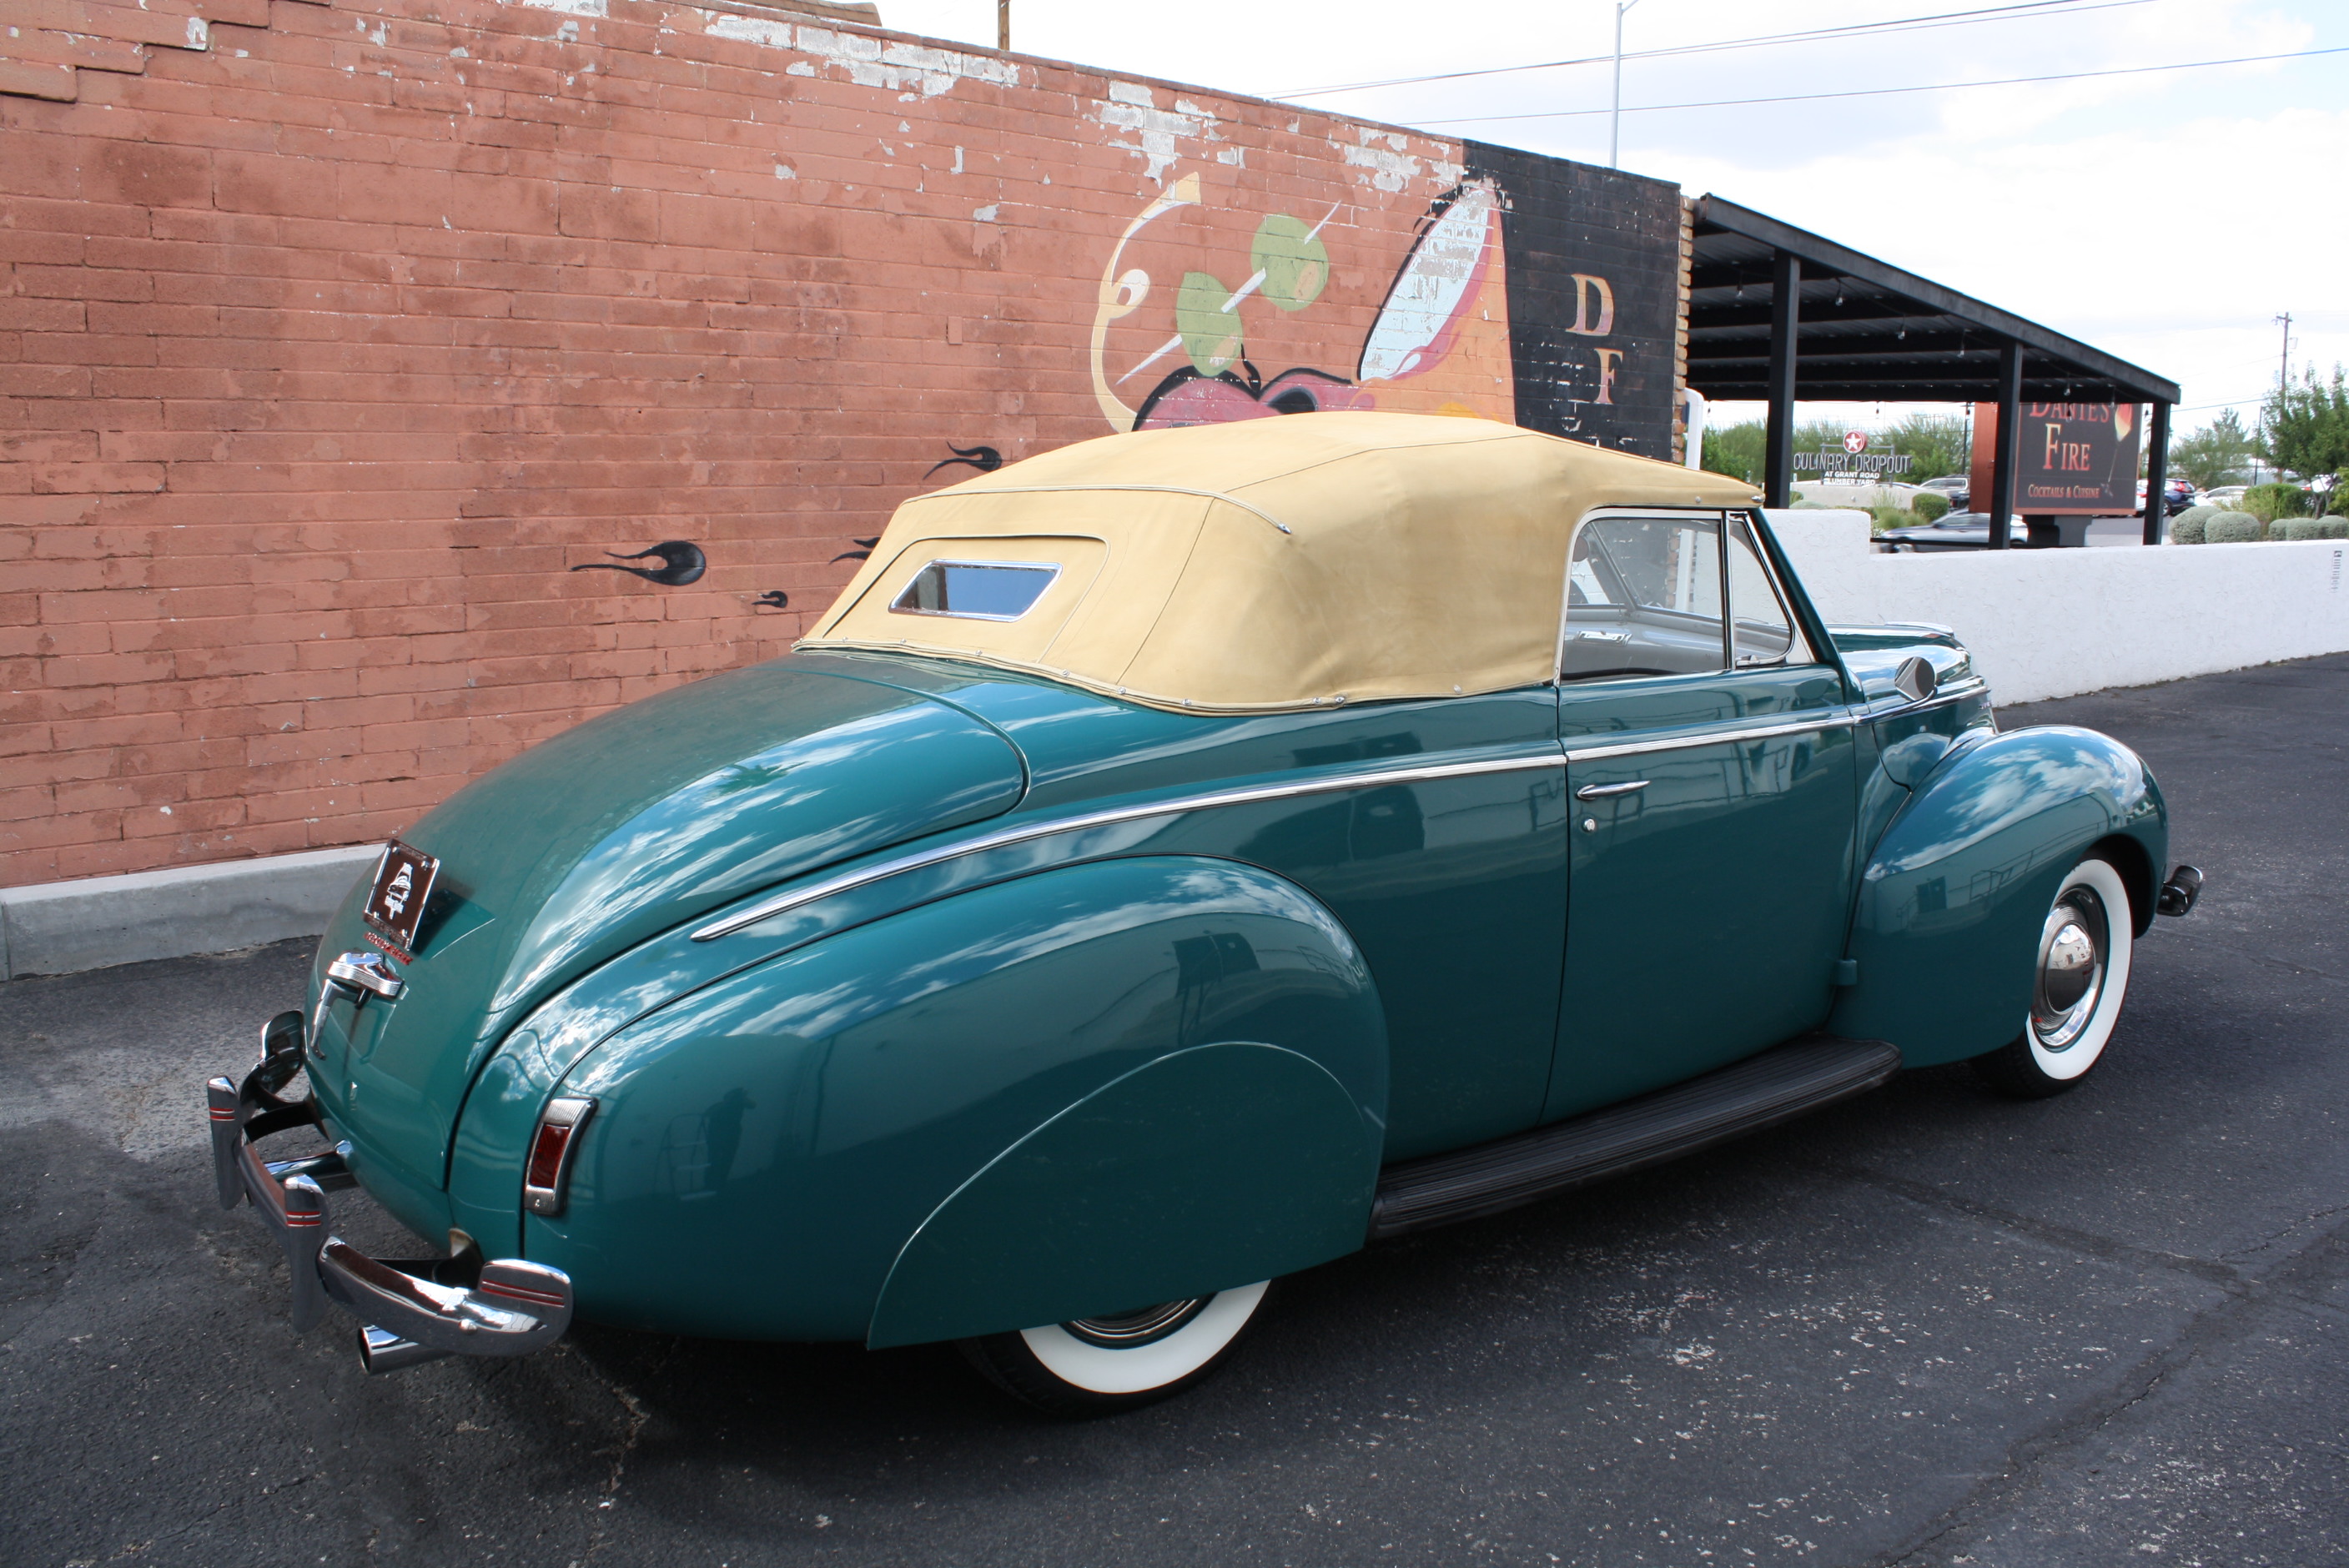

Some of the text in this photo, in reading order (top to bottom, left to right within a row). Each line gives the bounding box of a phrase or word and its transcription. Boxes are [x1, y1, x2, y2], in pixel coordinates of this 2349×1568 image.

[1566, 274, 1614, 336] D
[1594, 348, 1623, 405] F
[1793, 453, 1912, 474] CULINARY DROPOUT
[2043, 423, 2091, 471] FIRE
[2028, 484, 2100, 498] COCKTAILS & CUISINE
